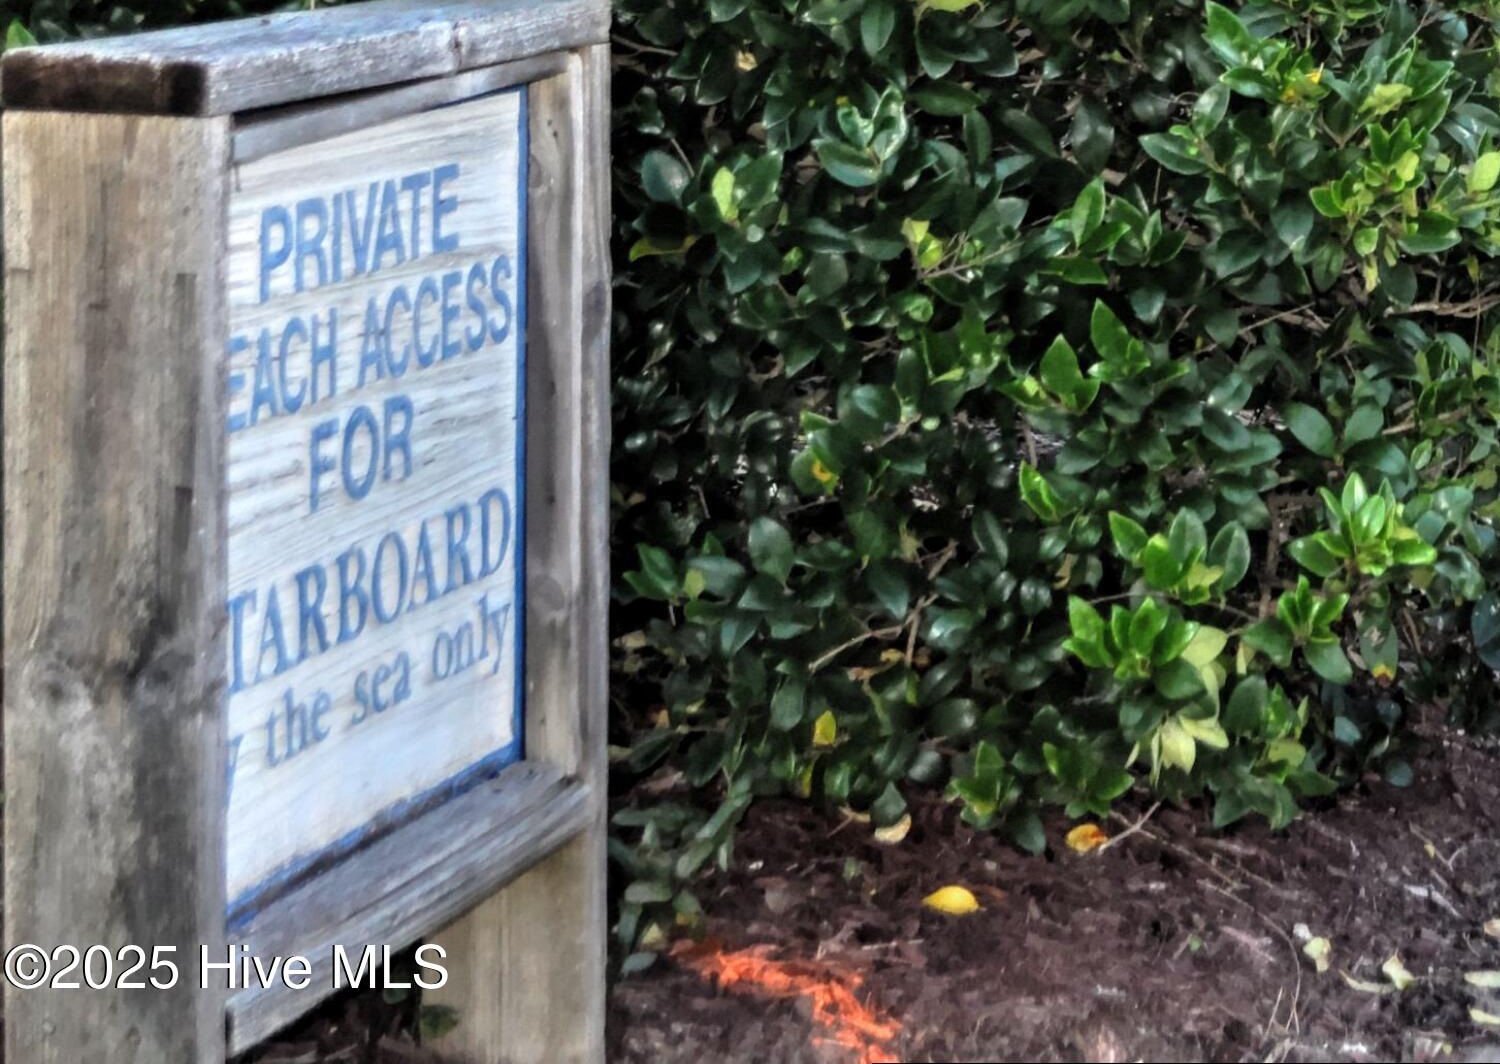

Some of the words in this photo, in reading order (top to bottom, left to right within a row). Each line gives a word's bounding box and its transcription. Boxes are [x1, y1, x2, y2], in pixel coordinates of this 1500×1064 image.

[259, 163, 460, 304] PRIVATE
[357, 254, 512, 389] ACCESS
[309, 394, 415, 513] FOR
[265, 686, 331, 768] the
[351, 651, 412, 725] sea
[432, 593, 511, 679] only
